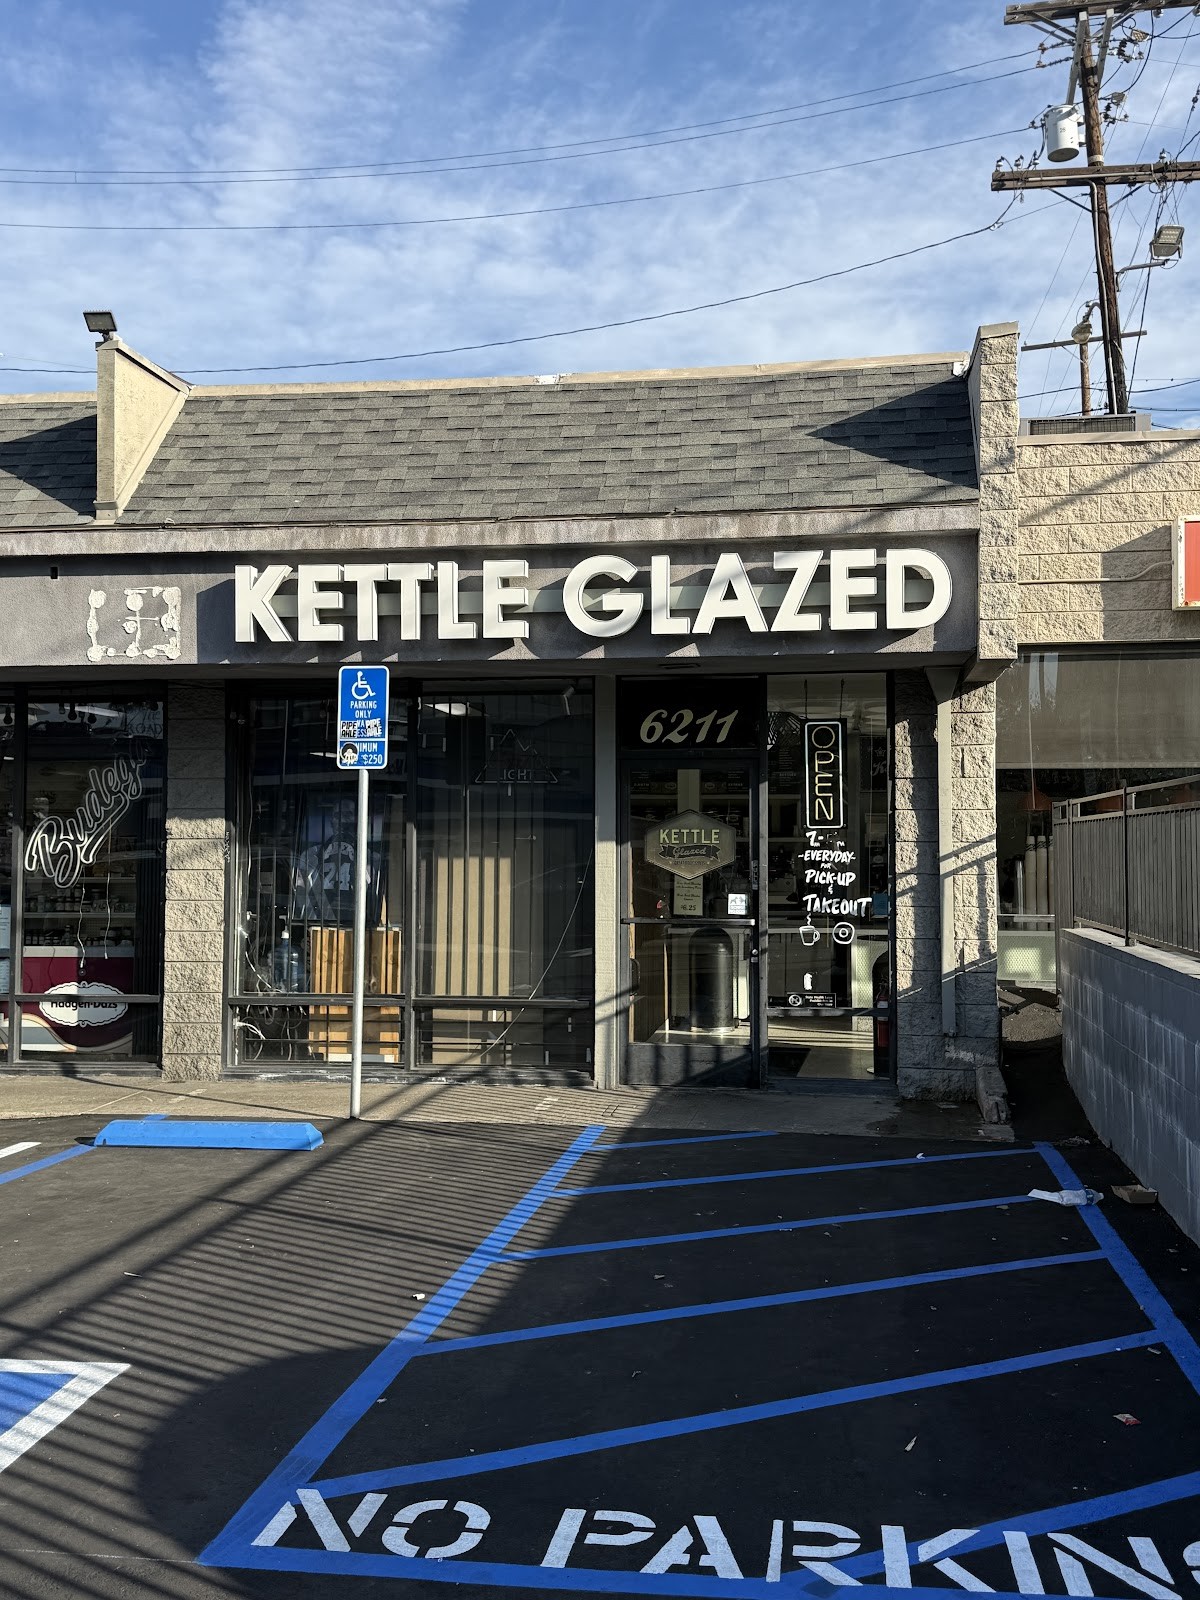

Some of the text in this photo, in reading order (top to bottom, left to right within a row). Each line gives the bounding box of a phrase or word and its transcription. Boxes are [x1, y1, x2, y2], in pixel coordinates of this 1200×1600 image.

[235, 548, 952, 642] KETTLE GLAZED
[350, 701, 377, 709] PARKING
[355, 710, 371, 718] ONLY
[640, 709, 739, 743] 6211
[363, 754, 383, 765] $250
[812, 726, 836, 820] OPEN
[659, 829, 720, 844] KETTLE
[804, 869, 857, 887] PICK-UP
[803, 894, 873, 918] TAKEOUT
[250, 1488, 1200, 1599] NO PARKIN
